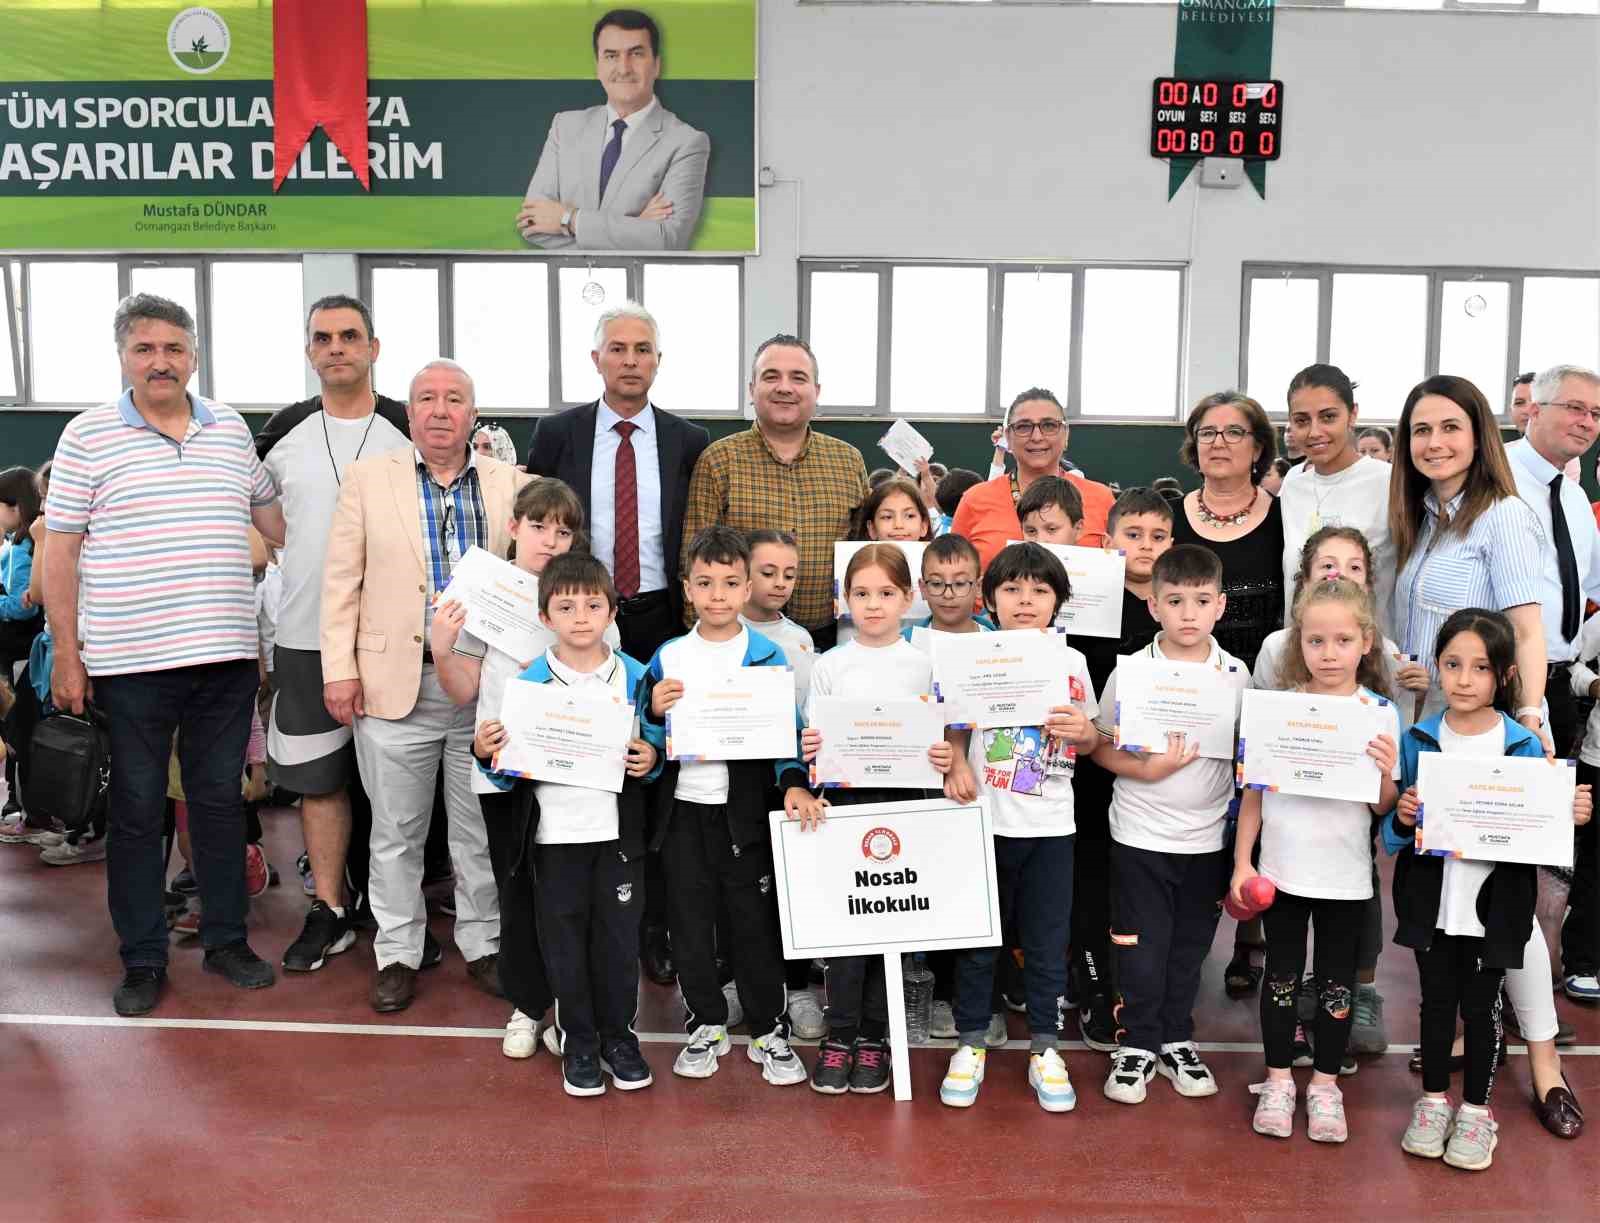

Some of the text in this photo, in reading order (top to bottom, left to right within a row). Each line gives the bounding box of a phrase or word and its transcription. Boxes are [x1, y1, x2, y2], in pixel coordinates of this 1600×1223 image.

[1192, 86, 1201, 104] A
[1203, 83, 1218, 107] 0
[1232, 84, 1247, 107] 0
[73, 96, 411, 128] SPORCULAZA
[1157, 110, 1186, 122] OYUN
[1190, 133, 1199, 150] B
[1200, 130, 1215, 153] 0
[1229, 131, 1244, 154] 0
[1259, 132, 1274, 155] 0
[0, 133, 444, 190] AŞARILAR DLERİM
[143, 200, 268, 217] Mustafa DÜNDAR
[193, 221, 236, 233] Belediye
[984, 774, 1011, 790] FUN
[855, 867, 918, 888] Nosab
[848, 894, 930, 916] İlkokulu
